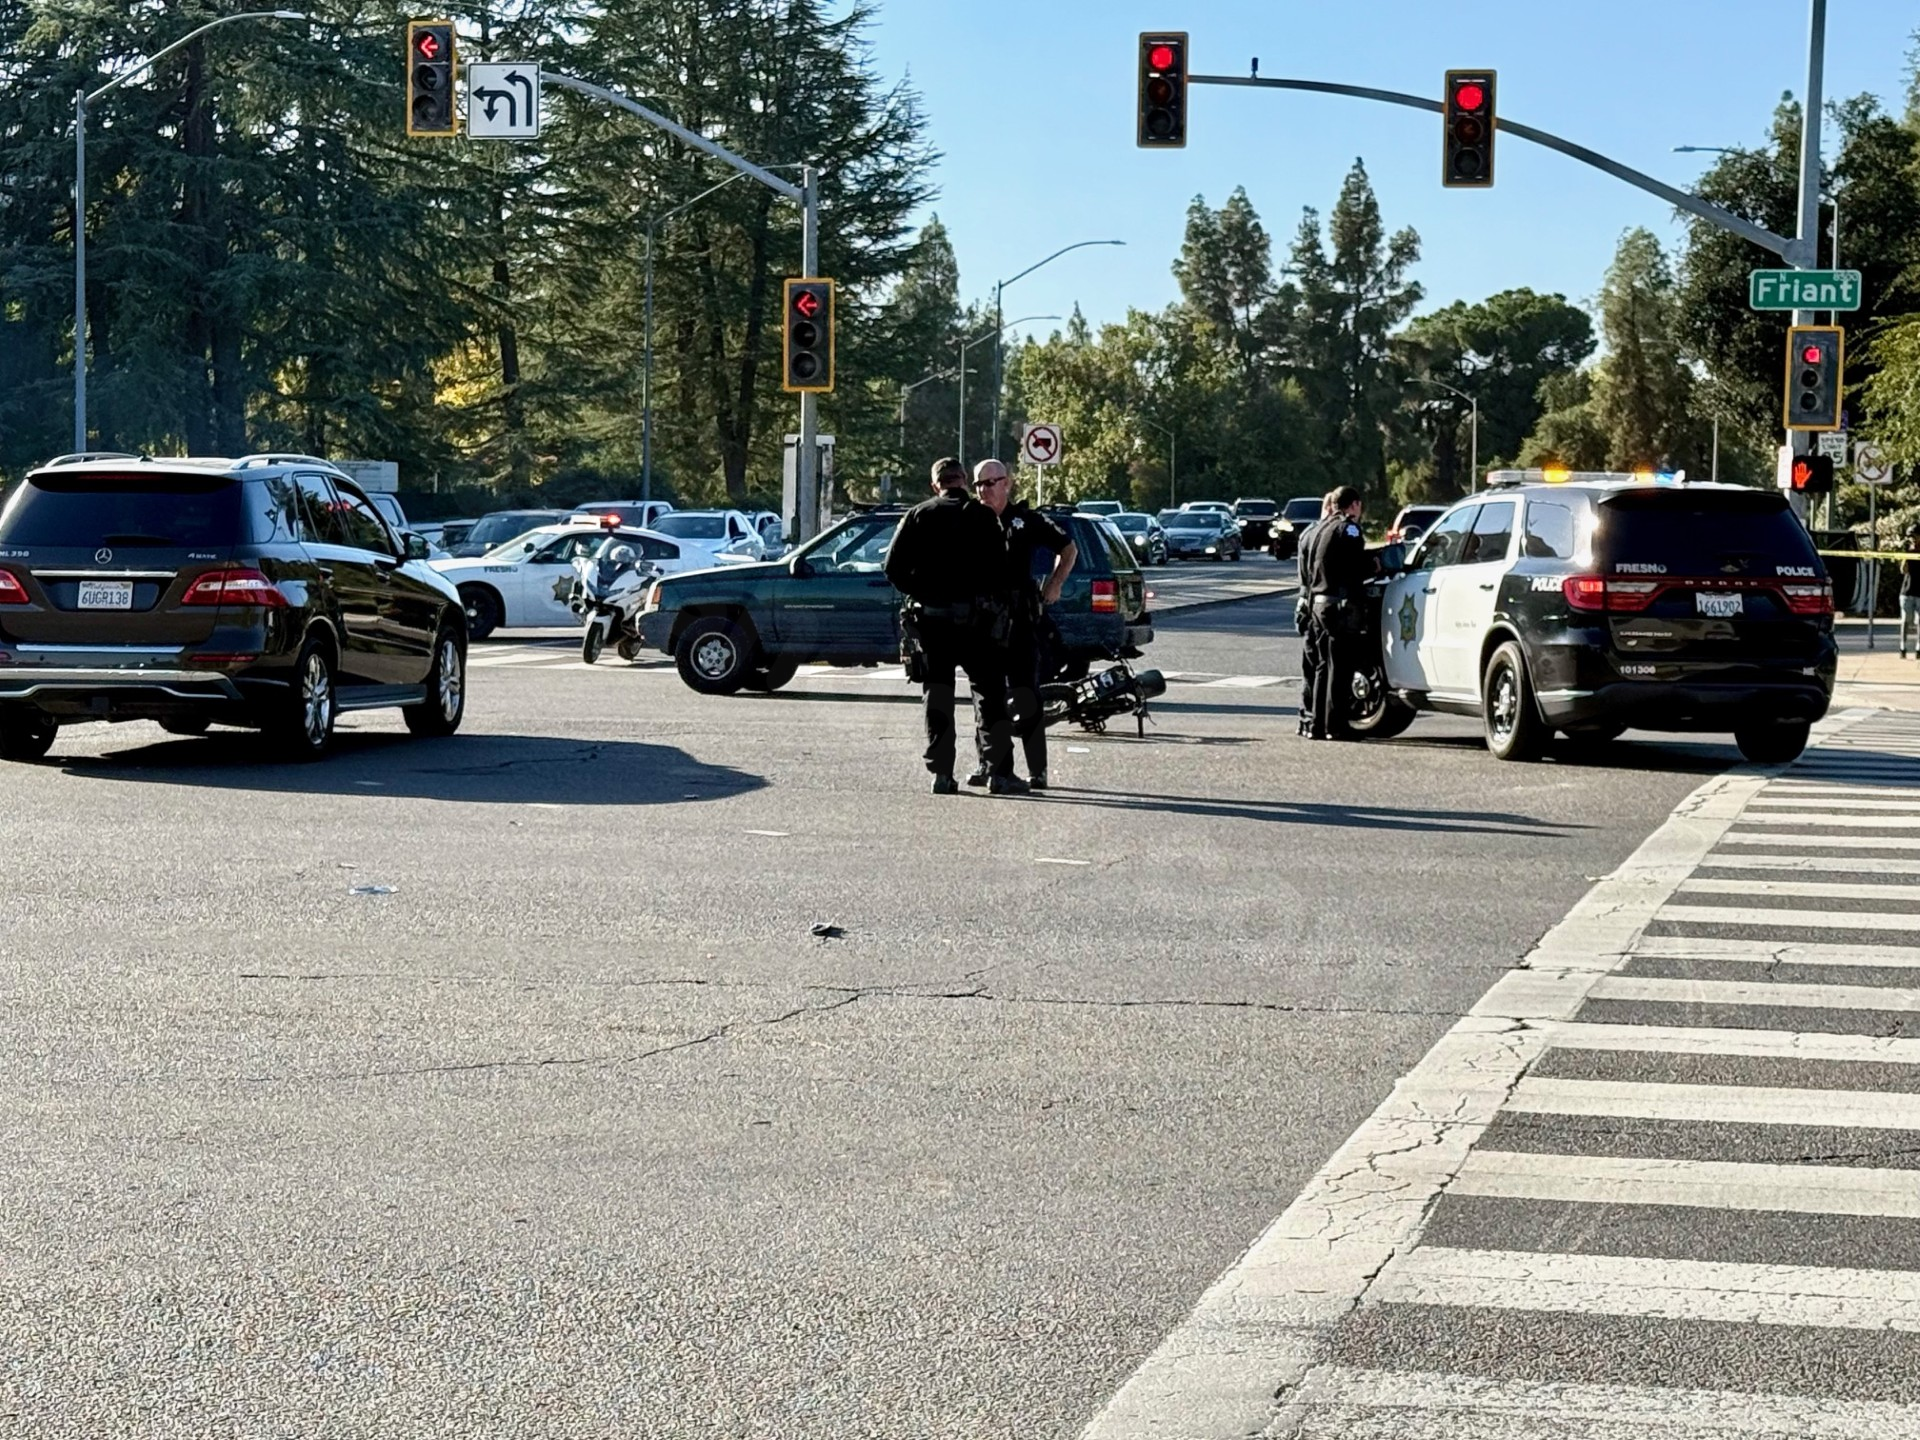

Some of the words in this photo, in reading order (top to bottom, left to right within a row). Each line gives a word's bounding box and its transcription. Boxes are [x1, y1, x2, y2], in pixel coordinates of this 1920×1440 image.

[1758, 278, 1853, 302] Friant
[1616, 563, 1667, 573] FRESNO
[1776, 566, 1816, 577] POLICE
[1531, 576, 1563, 592] POLICE
[81, 591, 129, 605] 6UGR138
